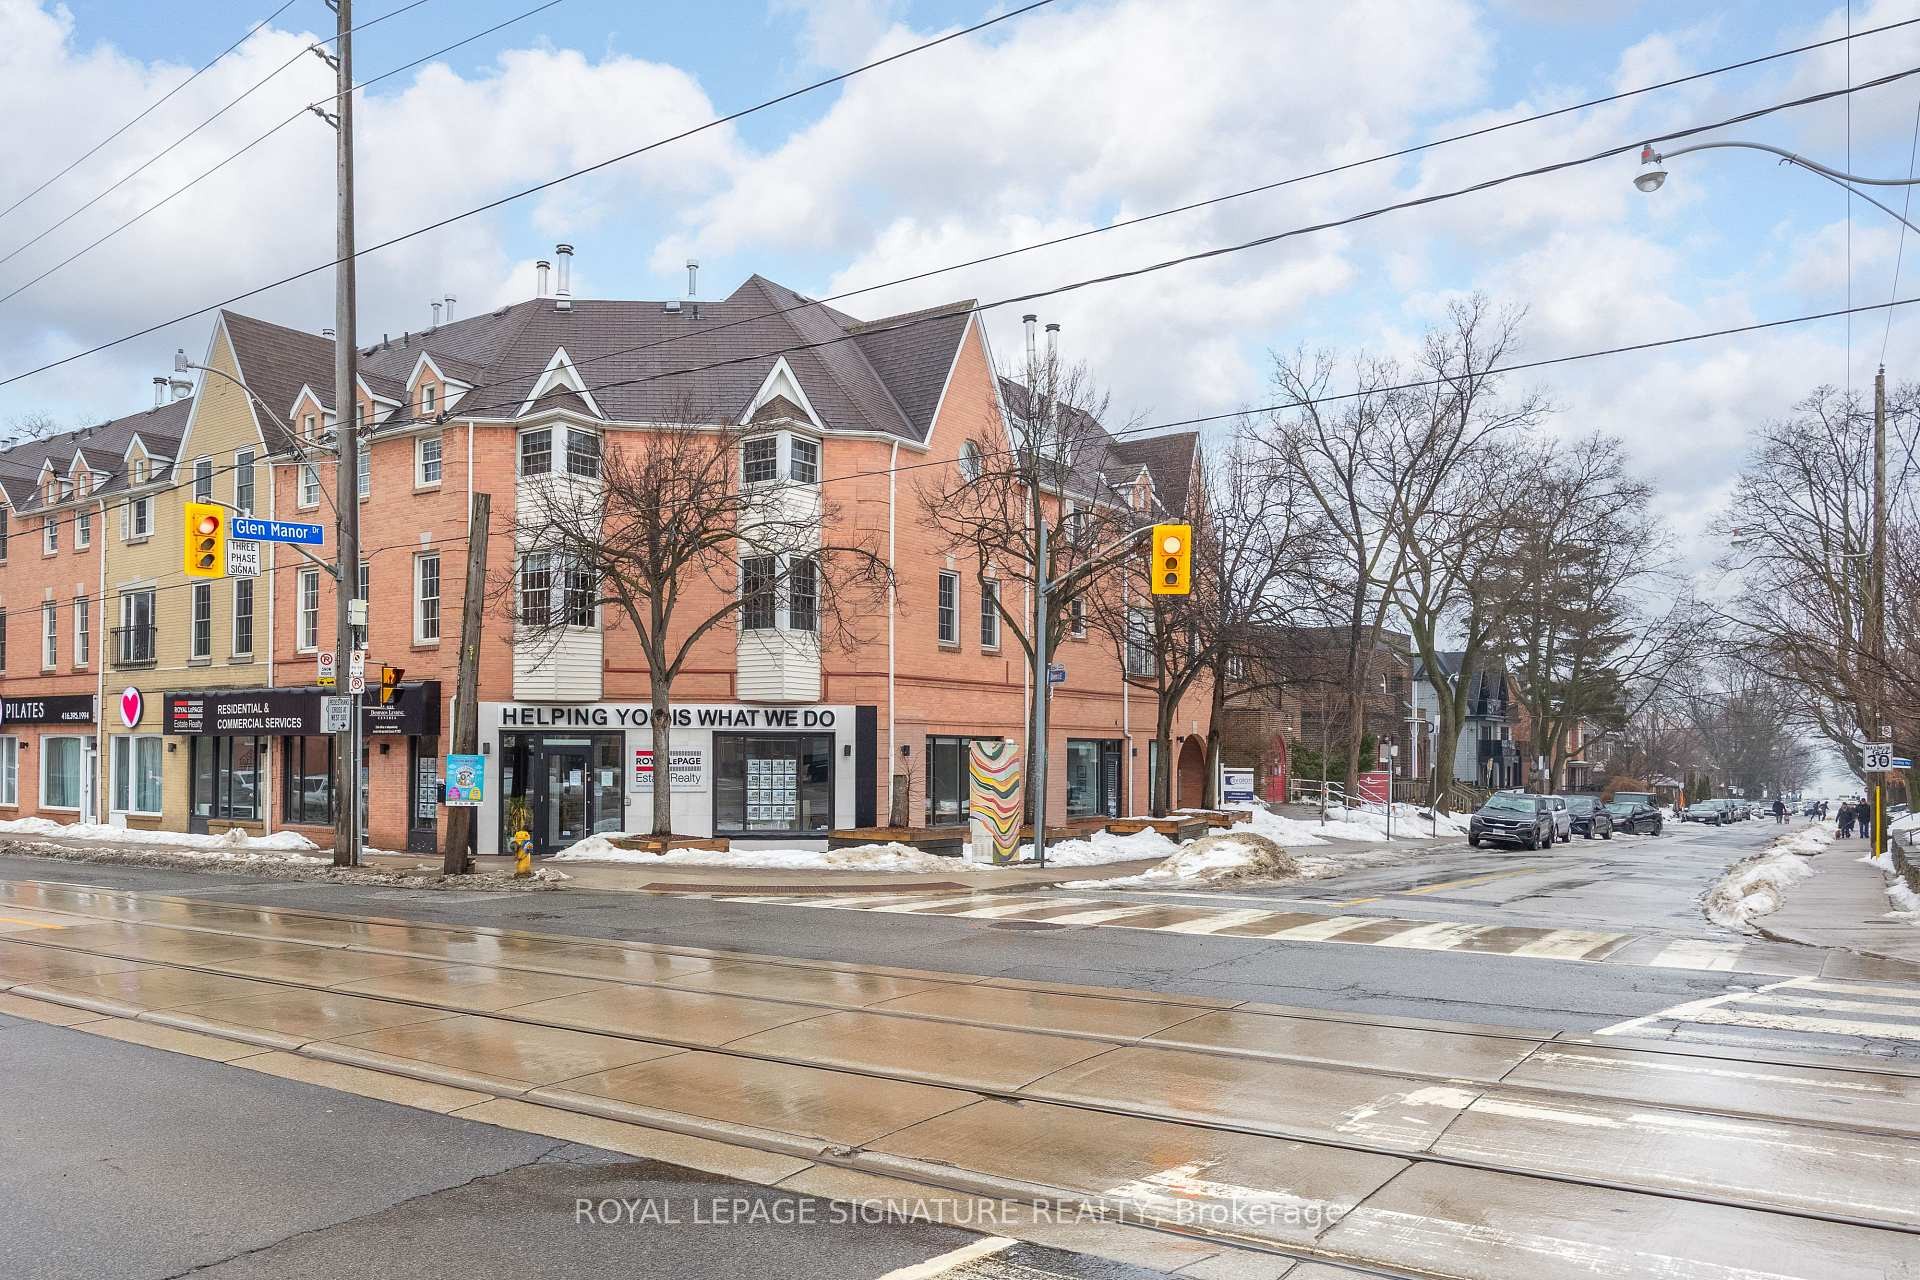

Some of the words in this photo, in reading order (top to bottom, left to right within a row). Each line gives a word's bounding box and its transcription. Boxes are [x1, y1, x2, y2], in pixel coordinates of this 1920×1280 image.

[236, 520, 265, 535] Glen
[270, 523, 308, 539] Manor
[232, 541, 256, 551] THREE
[231, 553, 256, 563] PHASE
[230, 564, 257, 575] SIGNAL
[5, 702, 44, 719] PILATES
[217, 704, 262, 715] RESIDENTIAL
[264, 703, 269, 713] &
[217, 718, 264, 729] COMMERCIAL
[265, 717, 302, 728] SERVICES
[502, 708, 608, 726] HELPING
[615, 709, 655, 726] YO
[672, 709, 691, 726] IS
[698, 709, 760, 726] WHAT
[764, 710, 798, 727] WE
[804, 710, 835, 727] DO
[174, 719, 188, 728] Estate
[188, 719, 203, 730] Realty
[636, 757, 654, 765] ROY
[1866, 755, 1889, 768] 30
[636, 772, 655, 783] Esta
[670, 772, 701, 784] Realty
